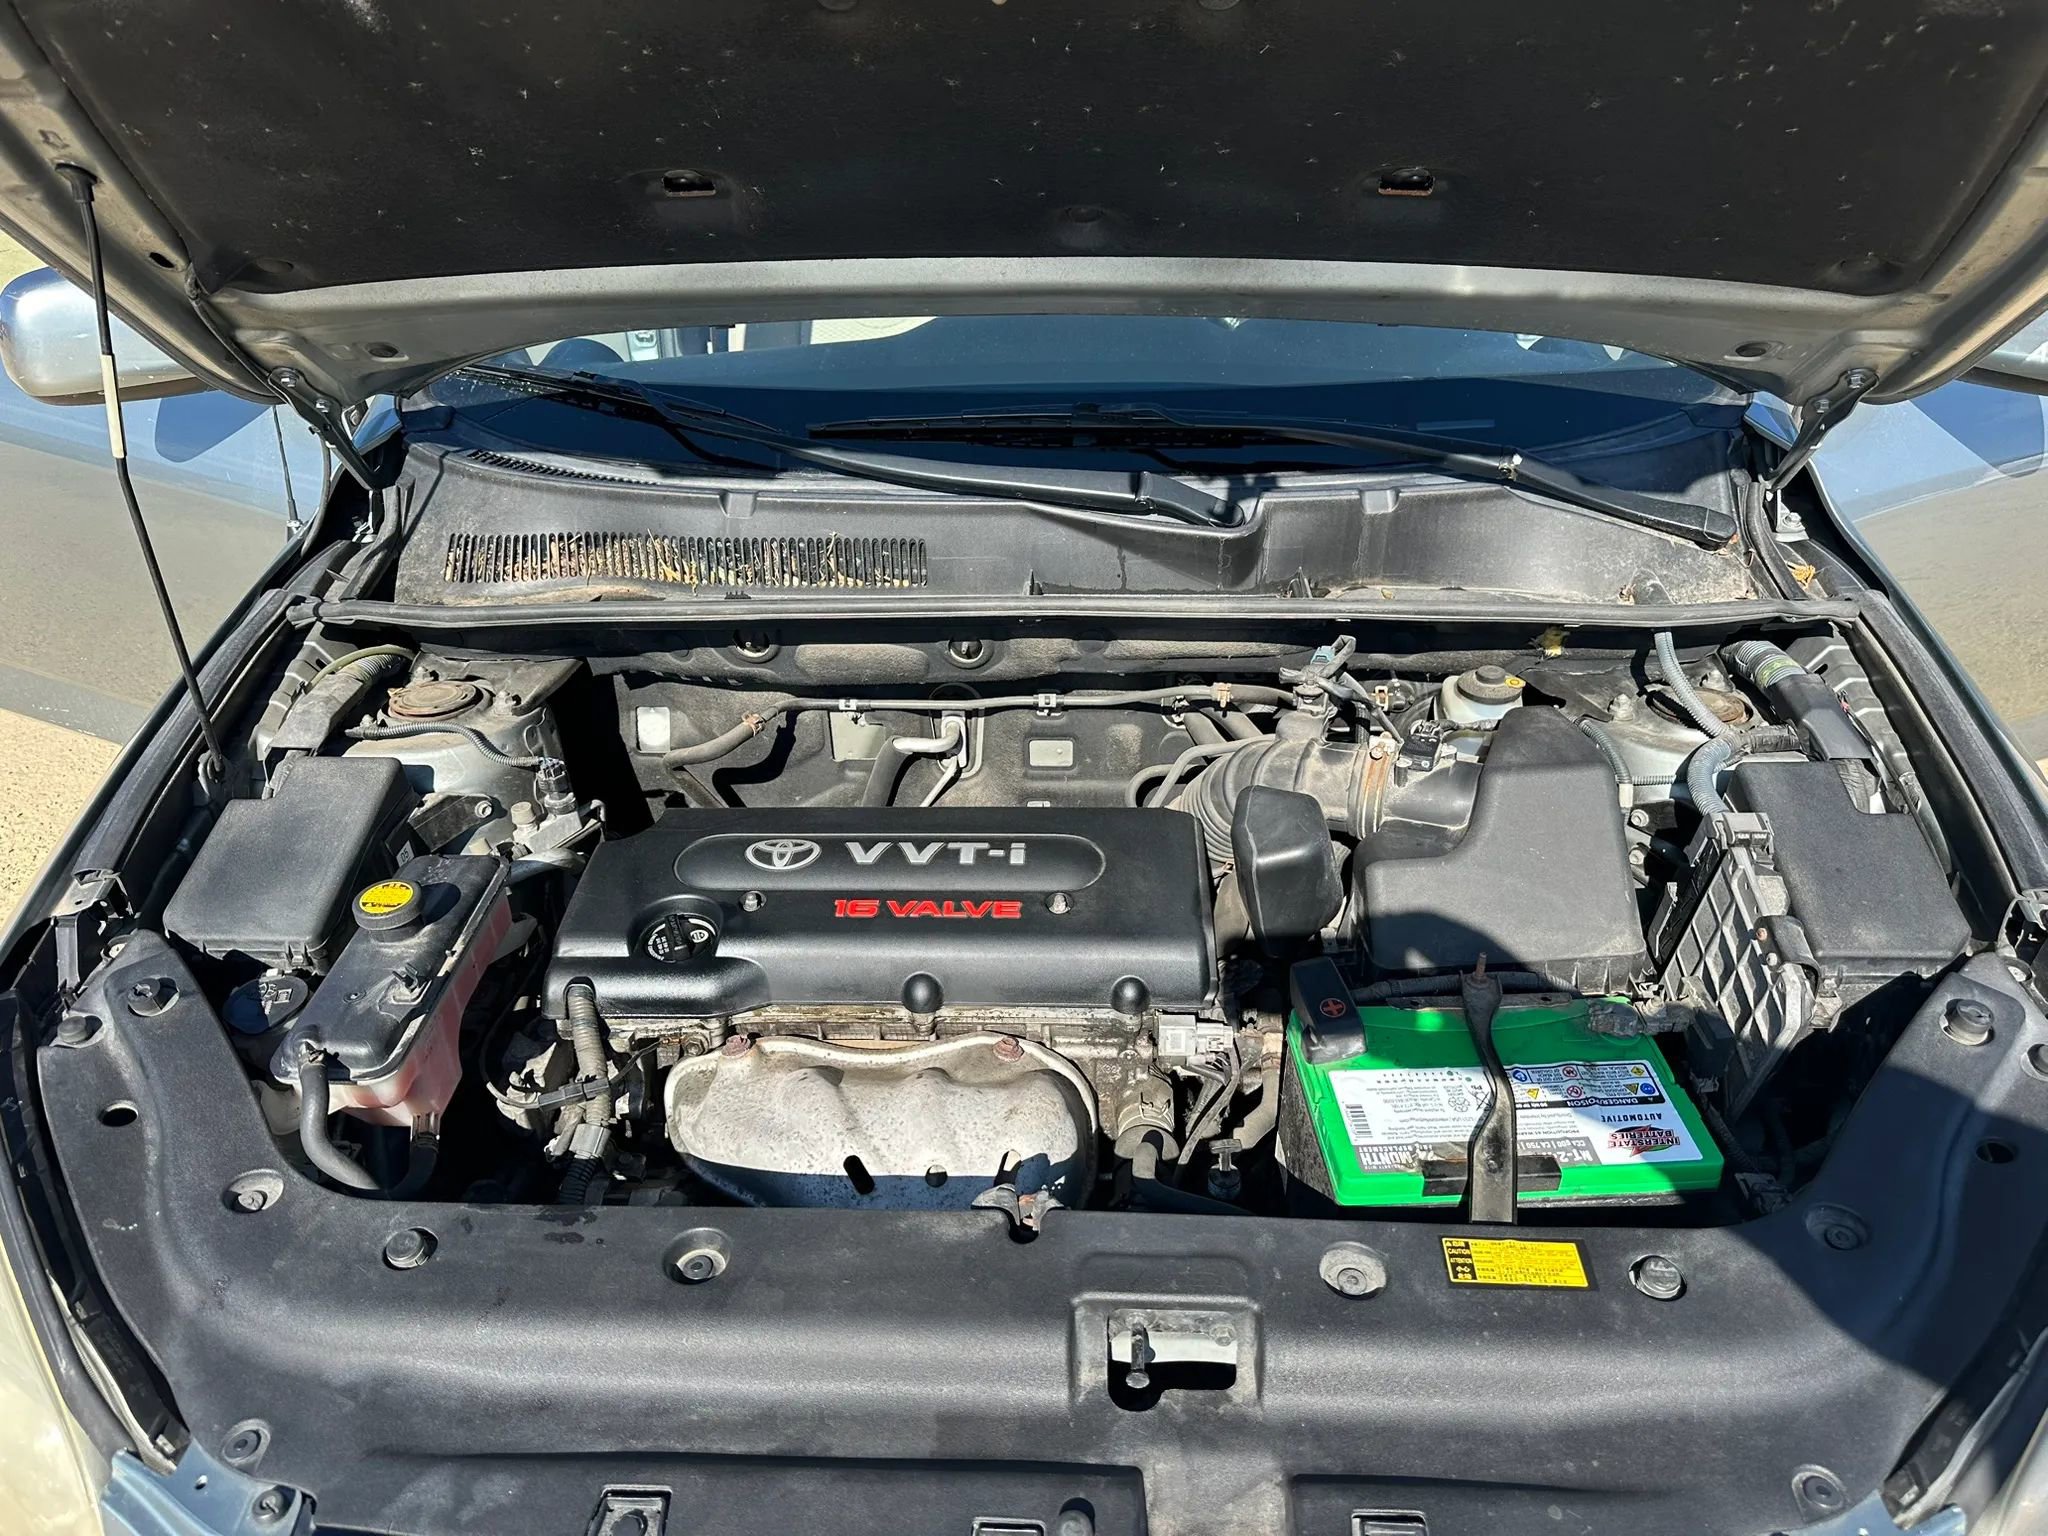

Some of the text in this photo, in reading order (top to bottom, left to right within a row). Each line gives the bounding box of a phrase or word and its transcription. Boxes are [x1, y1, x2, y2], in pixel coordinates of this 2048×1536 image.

[846, 841, 1026, 865] VVT-i
[834, 899, 1022, 919] 16 VALVE
[1601, 1112, 1662, 1123] AUTOMOTIVE
[1609, 1129, 1673, 1140] BATTERIES
[1608, 1137, 1680, 1148] INTERSTATE
